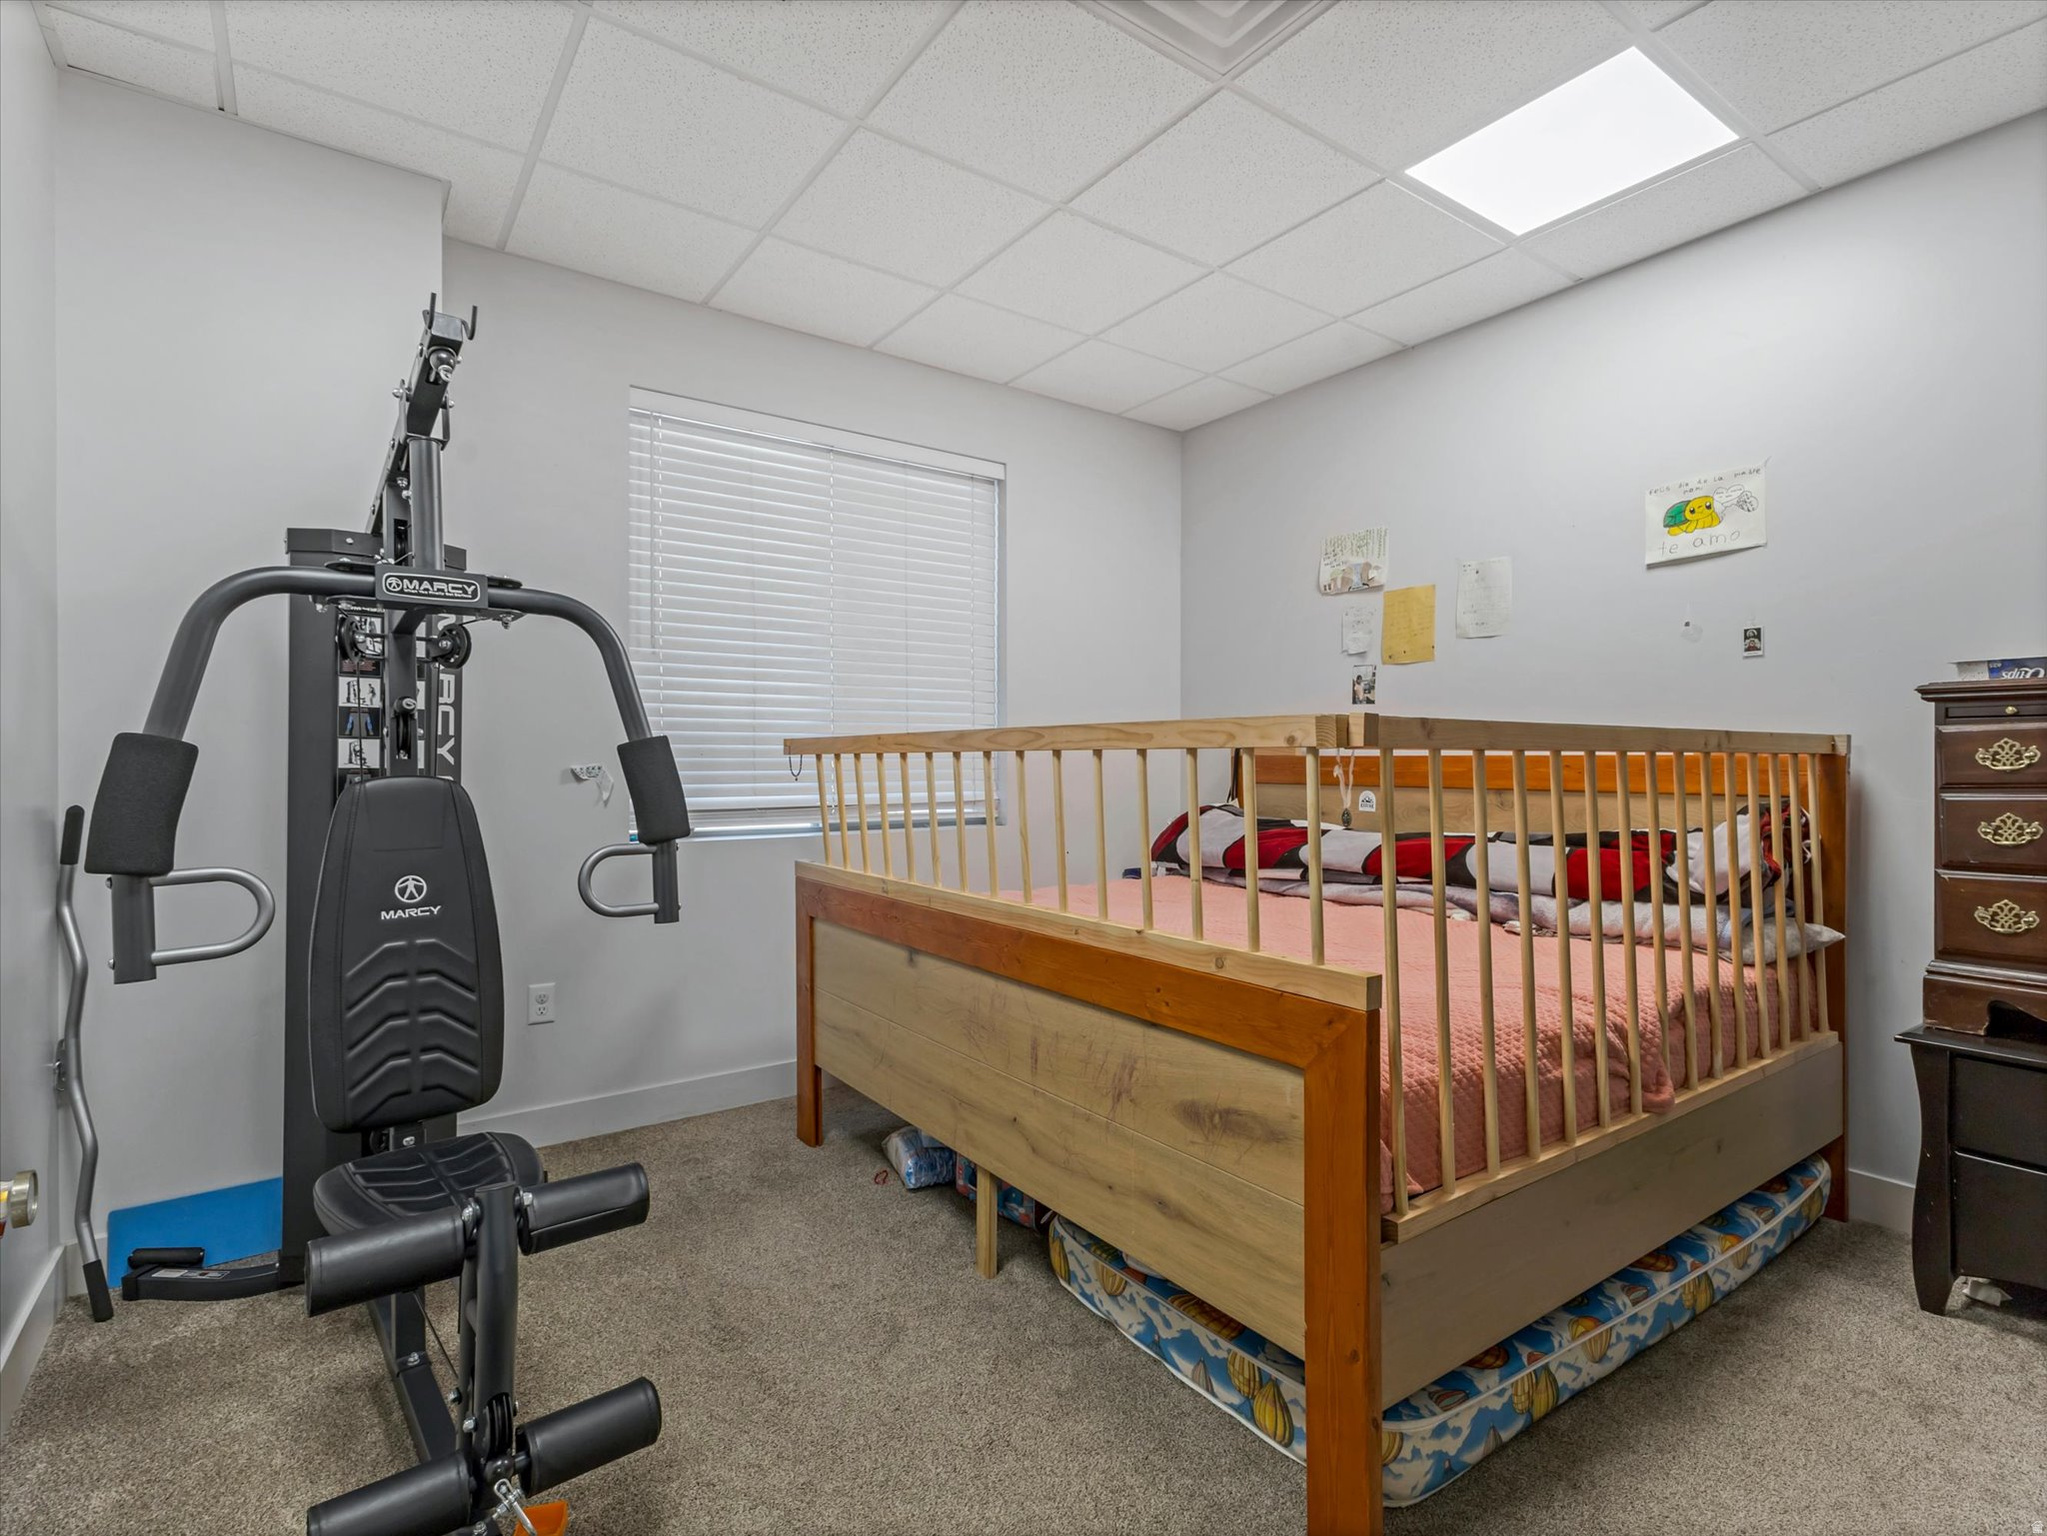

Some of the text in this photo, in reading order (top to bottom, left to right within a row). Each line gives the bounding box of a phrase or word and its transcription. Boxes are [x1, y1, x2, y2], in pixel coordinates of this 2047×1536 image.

[1659, 530, 1741, 556] te amo
[403, 579, 476, 595] MARCY
[381, 905, 441, 920] MARCY
